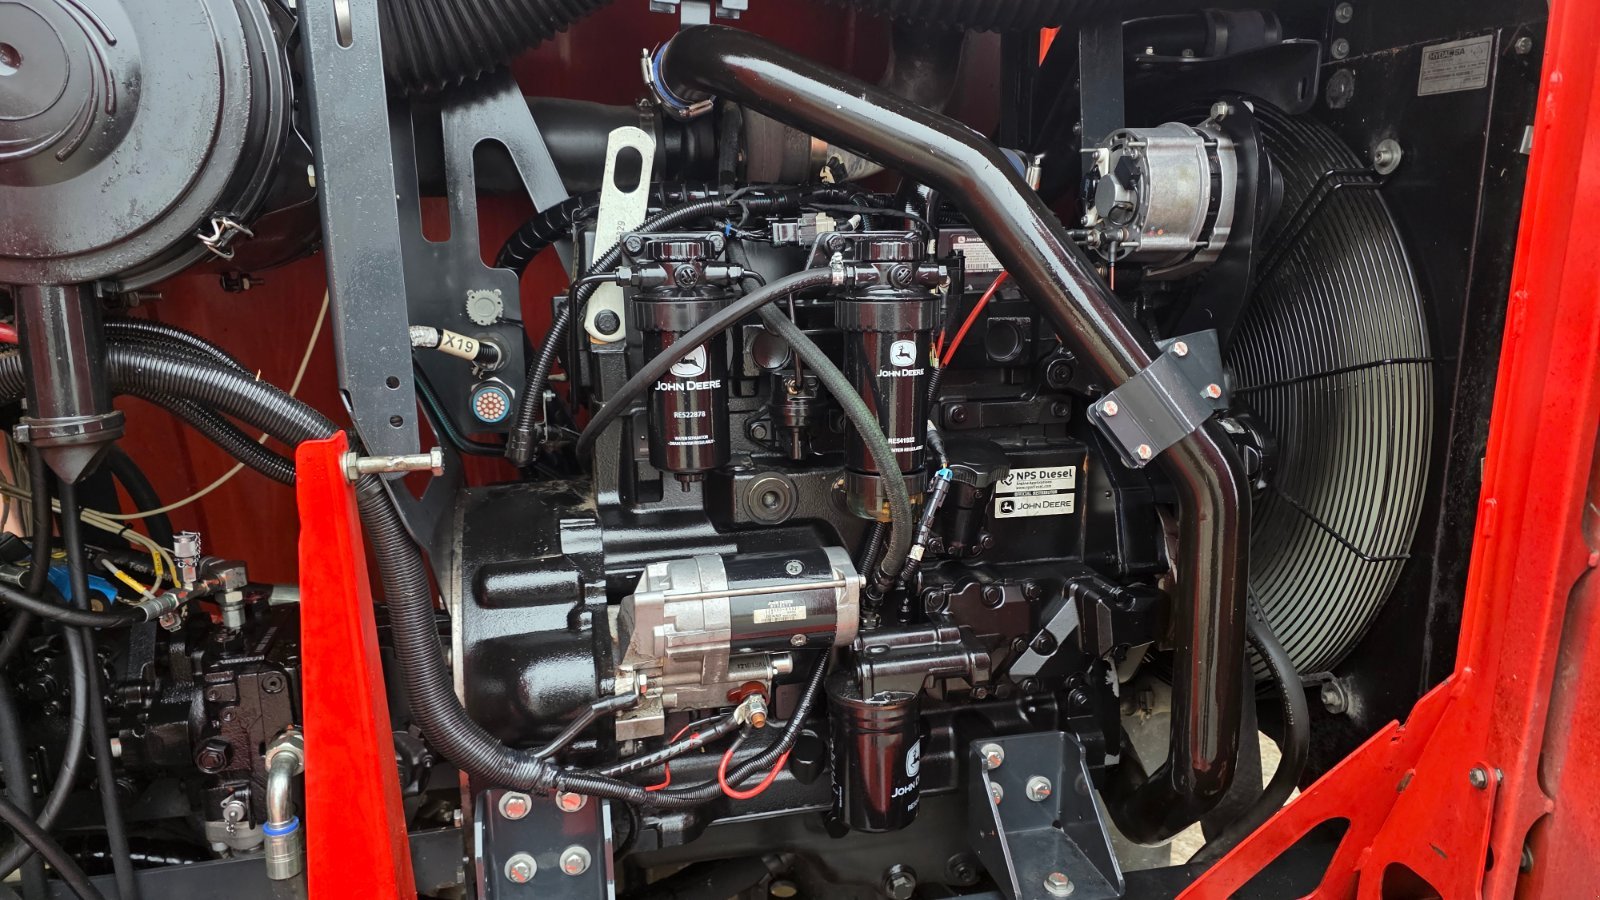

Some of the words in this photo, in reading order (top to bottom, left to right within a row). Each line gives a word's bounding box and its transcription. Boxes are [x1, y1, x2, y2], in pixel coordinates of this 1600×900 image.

[444, 333, 474, 353] X19
[877, 369, 901, 378] JOHN
[901, 368, 925, 377] DEERE
[655, 381, 684, 391] JOHN
[686, 380, 721, 390] DEERE
[1017, 471, 1037, 480] NPS
[1040, 469, 1072, 478] Diesel
[1018, 502, 1041, 510] JOHN
[891, 781, 915, 798] JOHN
